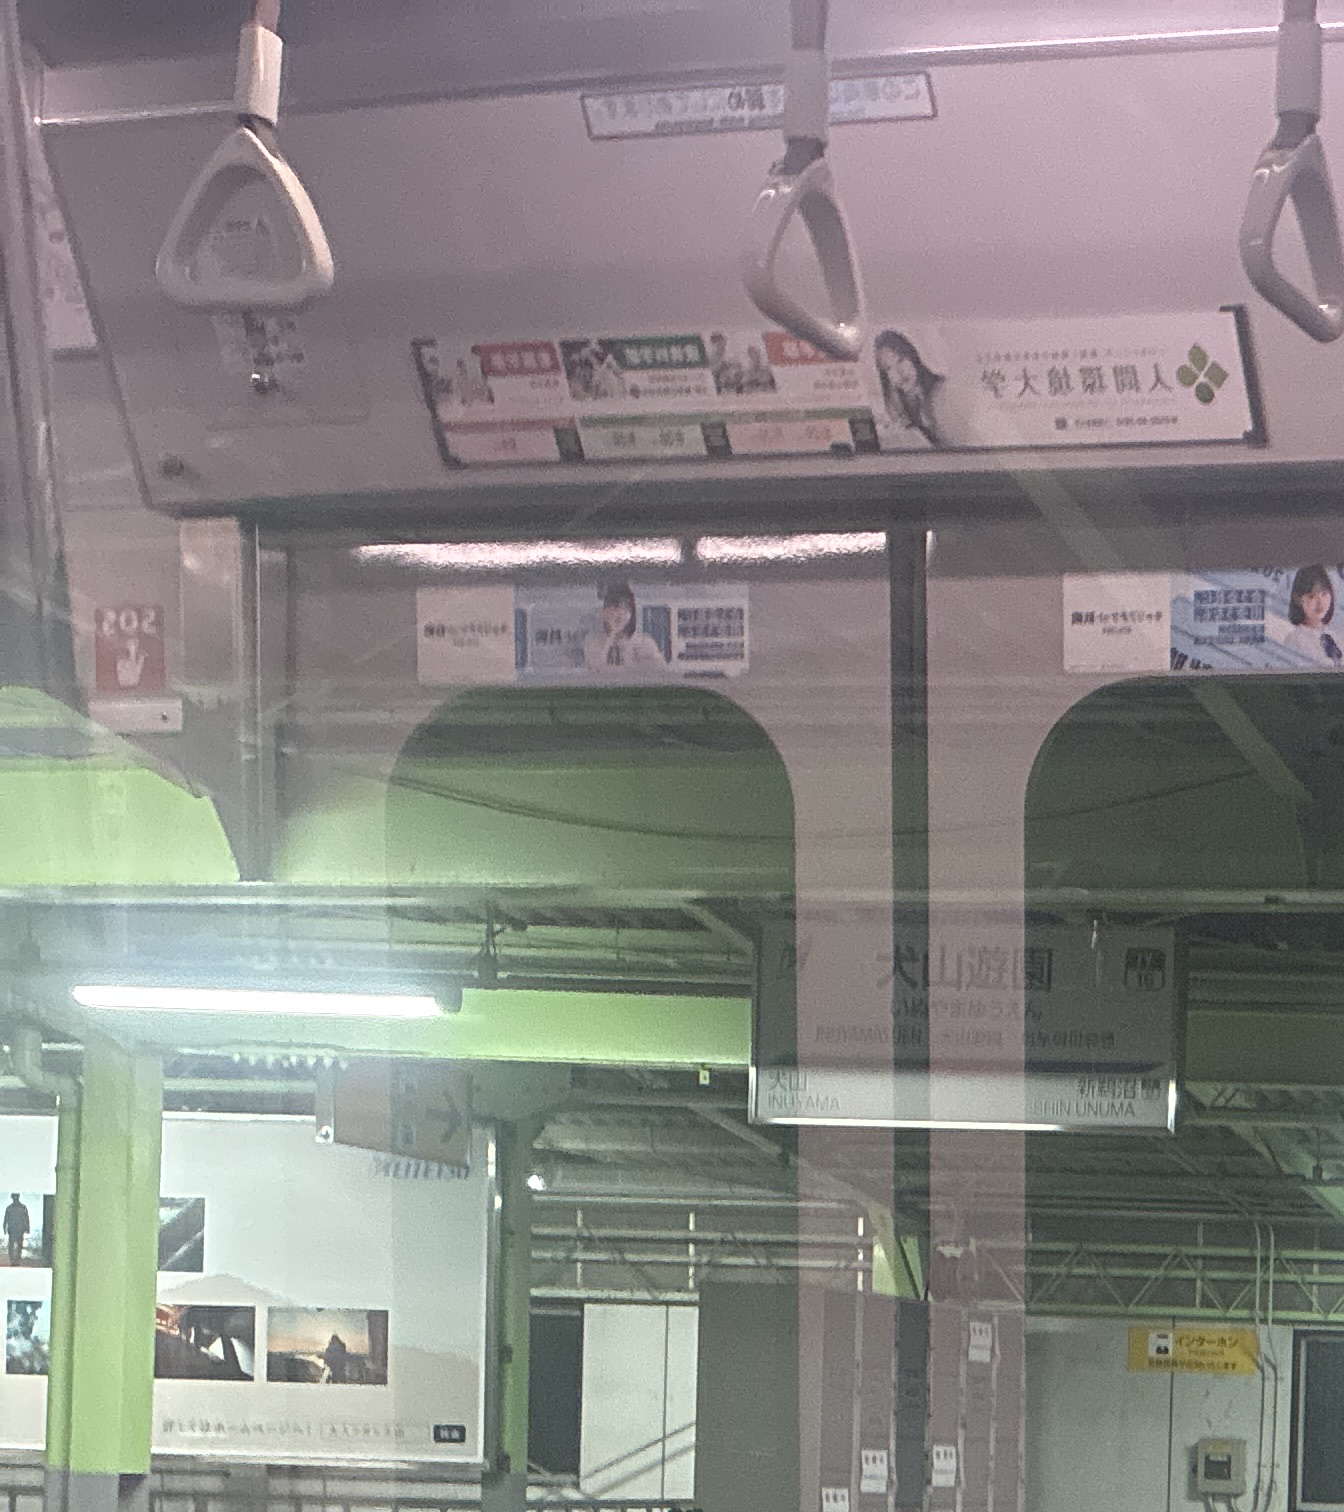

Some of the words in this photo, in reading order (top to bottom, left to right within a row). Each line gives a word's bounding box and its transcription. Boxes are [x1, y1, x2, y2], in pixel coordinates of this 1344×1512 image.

[876, 943, 1053, 993] 犬山遊園
[769, 1071, 808, 1092] 犬山
[767, 1093, 841, 1111] INUYAMA
[1075, 1100, 1136, 1119] UNUMA
